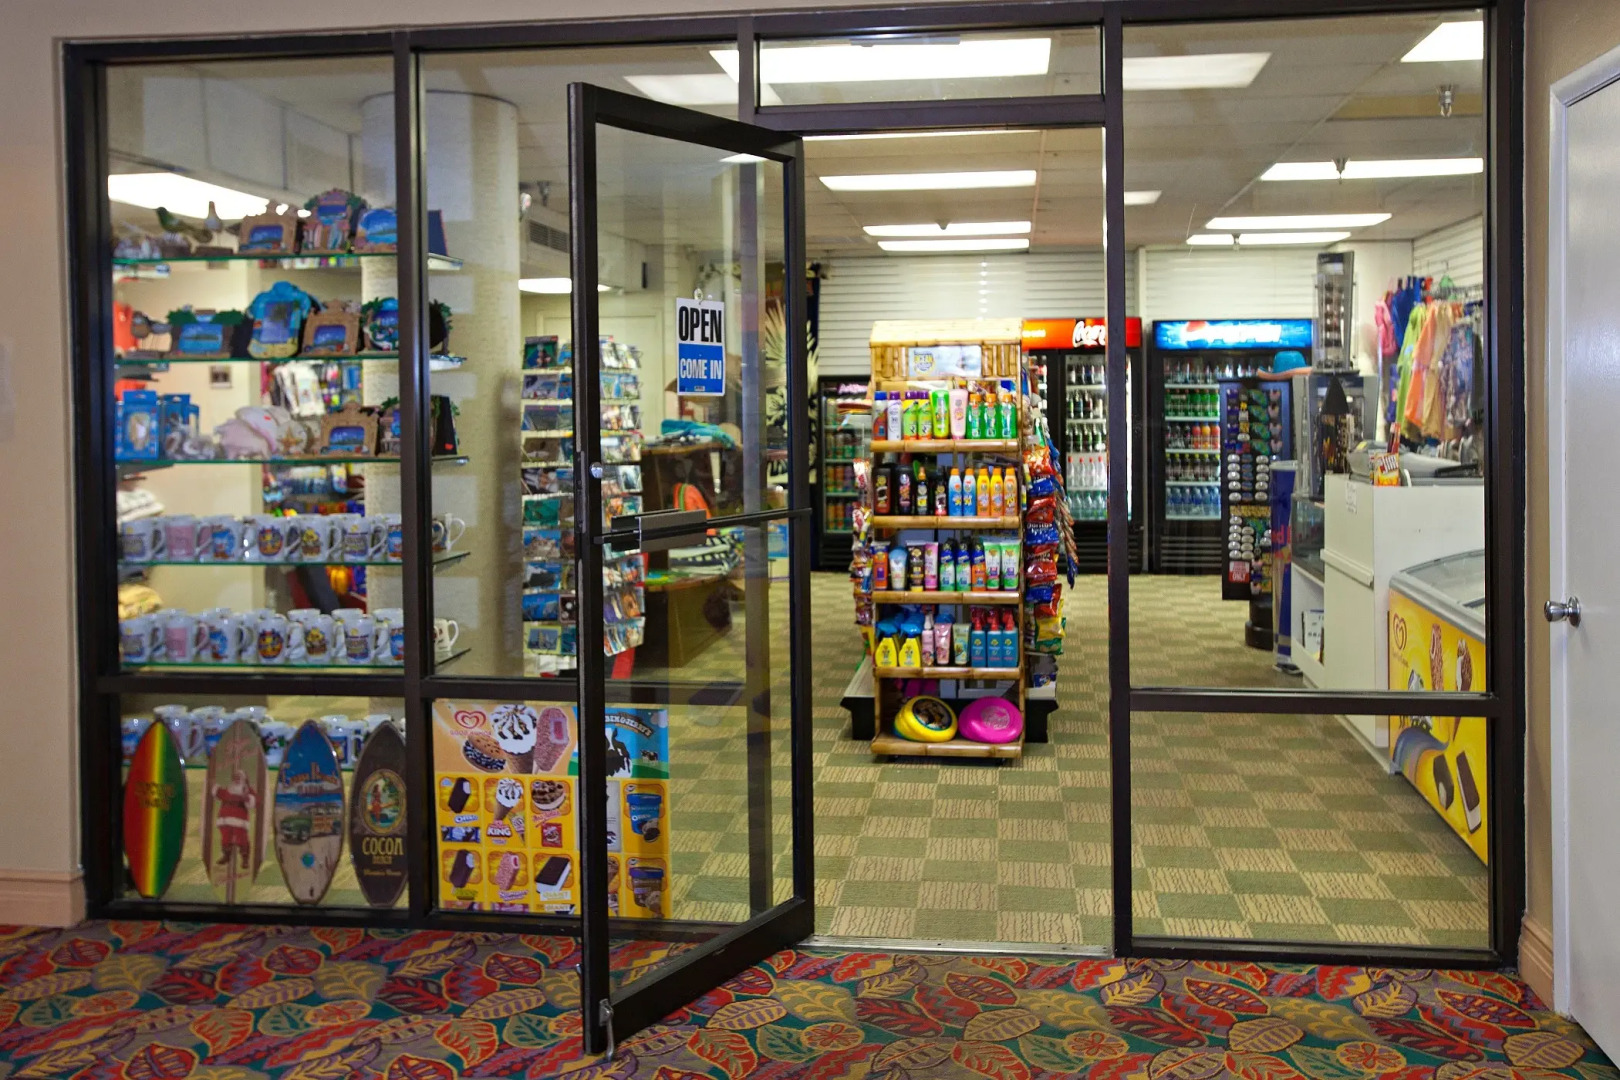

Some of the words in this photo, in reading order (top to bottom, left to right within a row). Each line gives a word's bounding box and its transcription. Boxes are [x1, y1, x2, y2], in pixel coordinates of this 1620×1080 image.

[679, 306, 722, 343] OPEN
[680, 358, 708, 379] COME
[710, 360, 722, 380] IN
[487, 827, 511, 837] KING
[362, 837, 404, 855] COCOA
